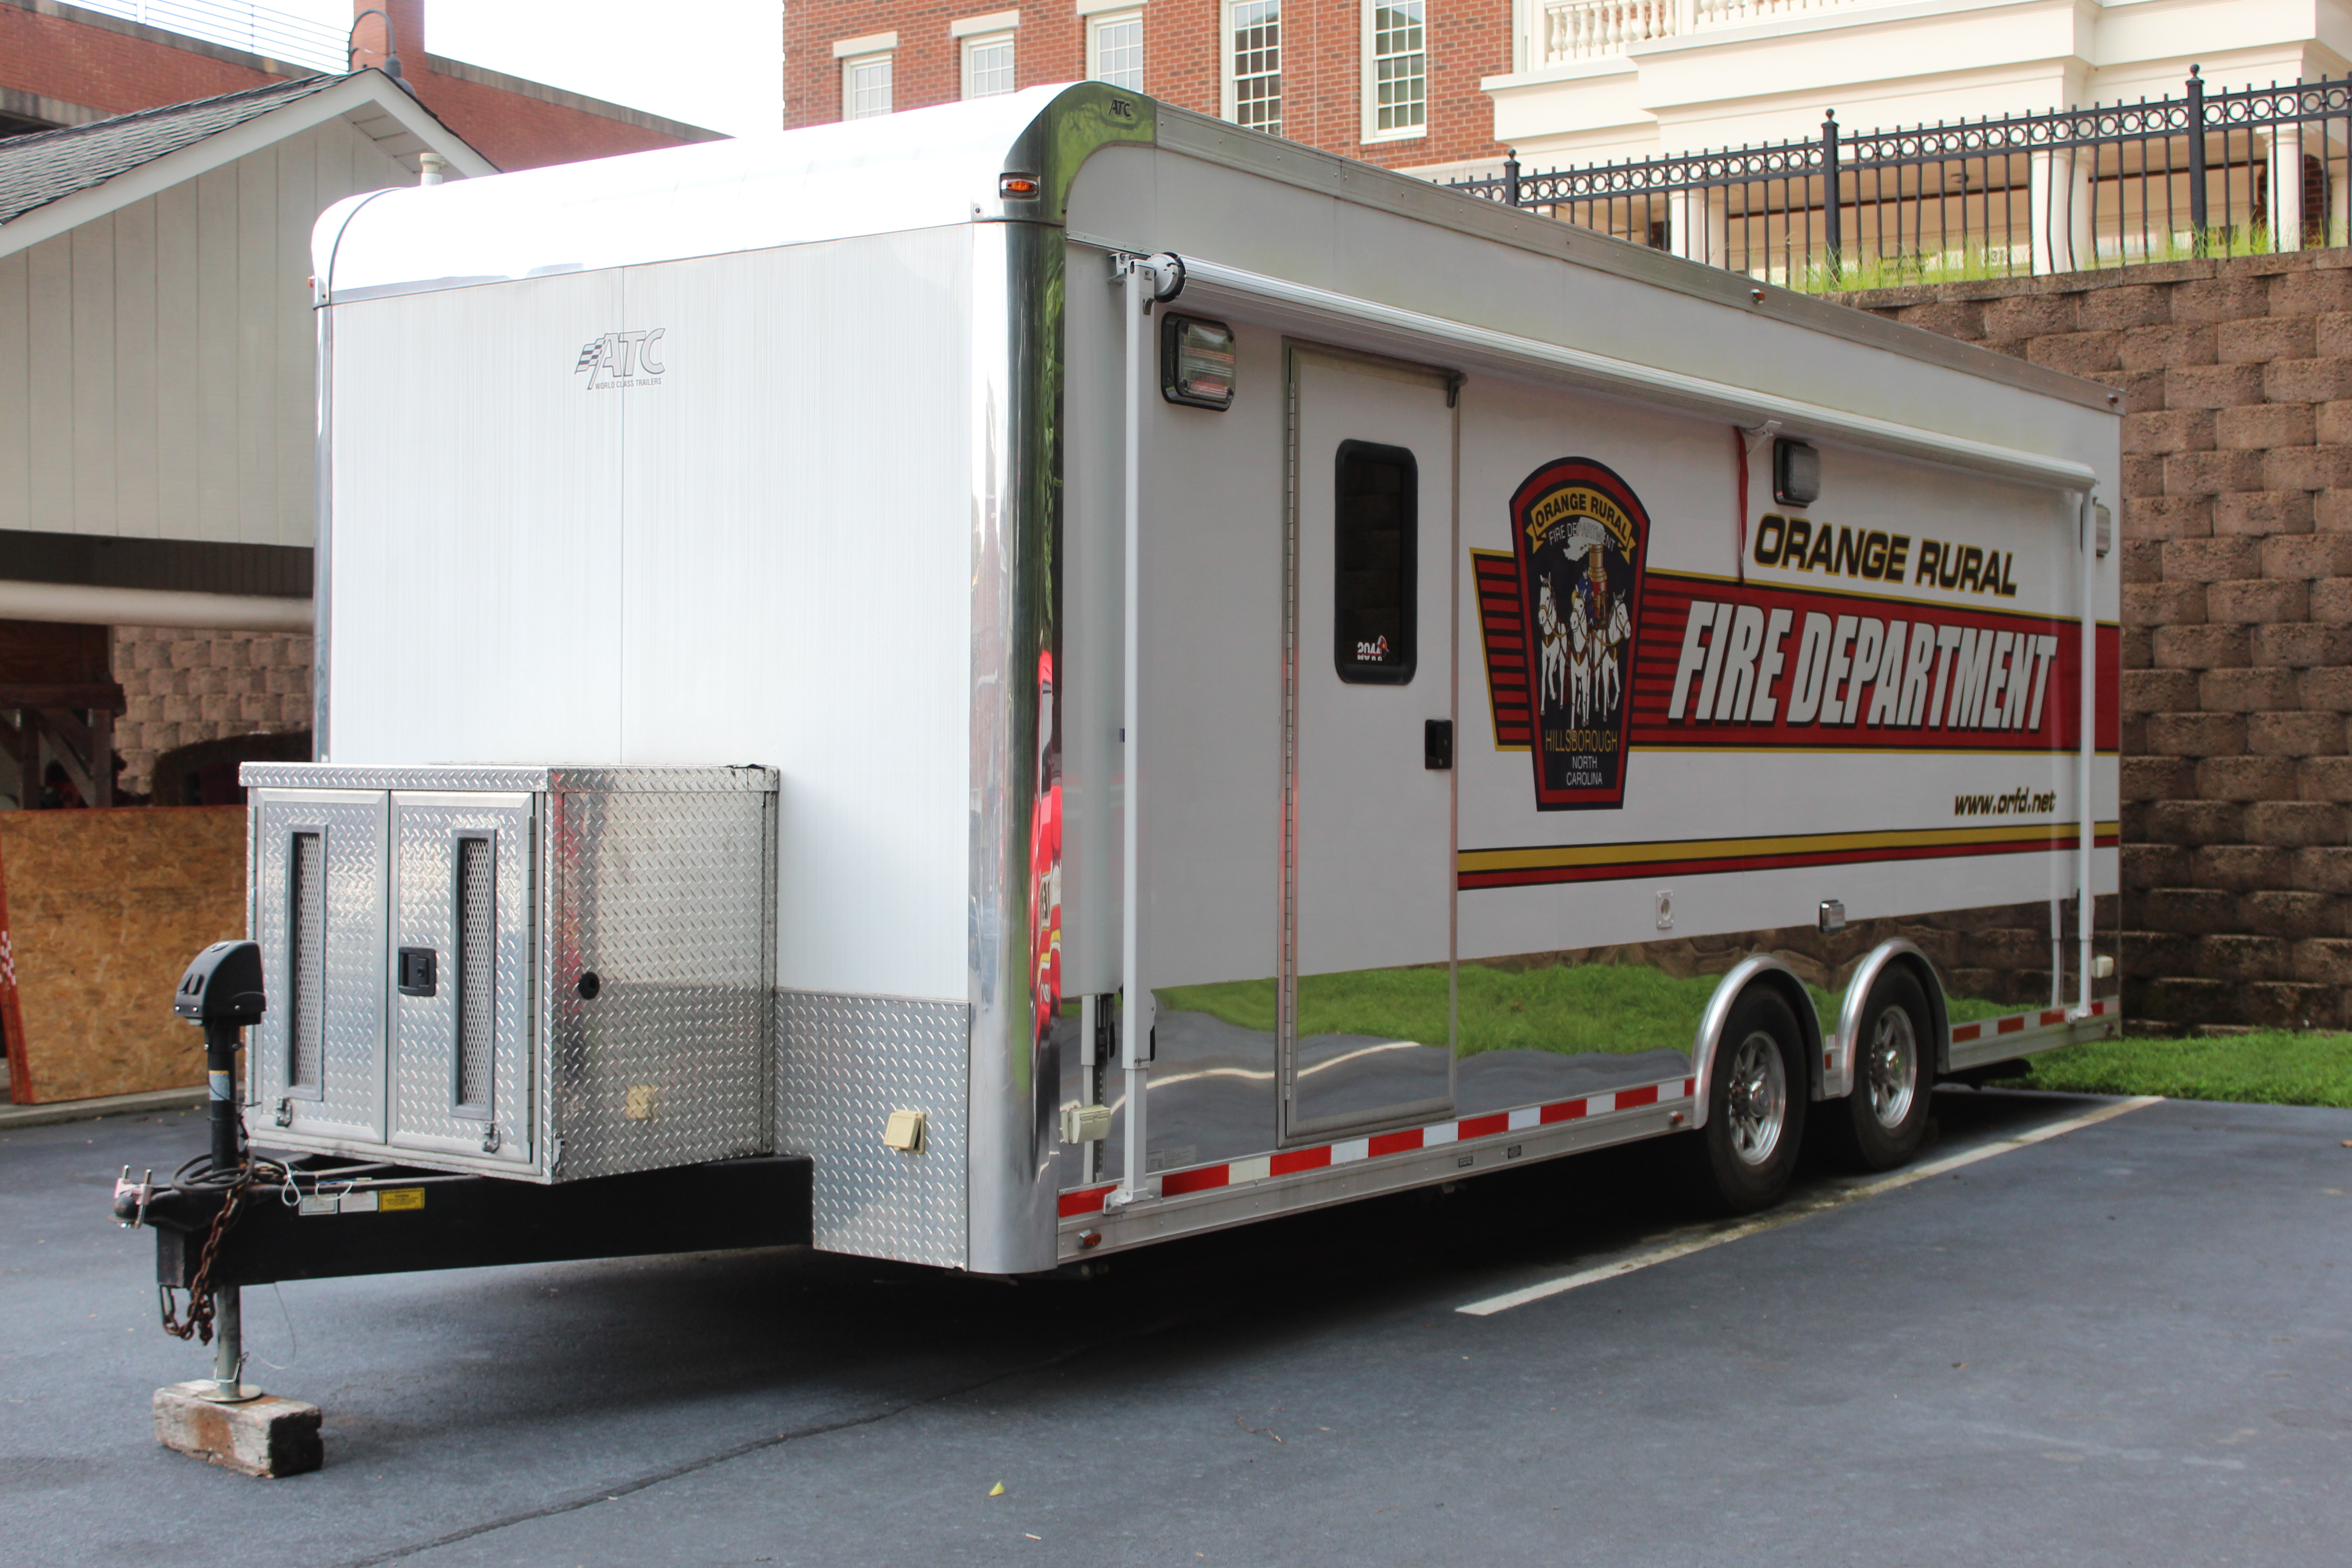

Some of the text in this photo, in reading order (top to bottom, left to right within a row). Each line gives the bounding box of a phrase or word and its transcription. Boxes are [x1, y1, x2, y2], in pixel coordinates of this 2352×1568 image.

[1108, 99, 1131, 118] ATC
[587, 328, 666, 390] ATC
[595, 377, 662, 390] WORLD CLASS TRAILERS
[1535, 493, 1627, 540] ORANGE RURAL
[1548, 522, 1616, 552] FIRE DEPARTMENT
[1754, 513, 2018, 598] ORANGE RURAL
[1668, 600, 2058, 732] FIRE DEPARTMENT
[1545, 730, 1617, 752] HILLSBOROUGH
[1572, 755, 1597, 769] NORTH
[1566, 772, 1602, 786] CAROLINA
[1954, 787, 2057, 816] www.orfd.net
